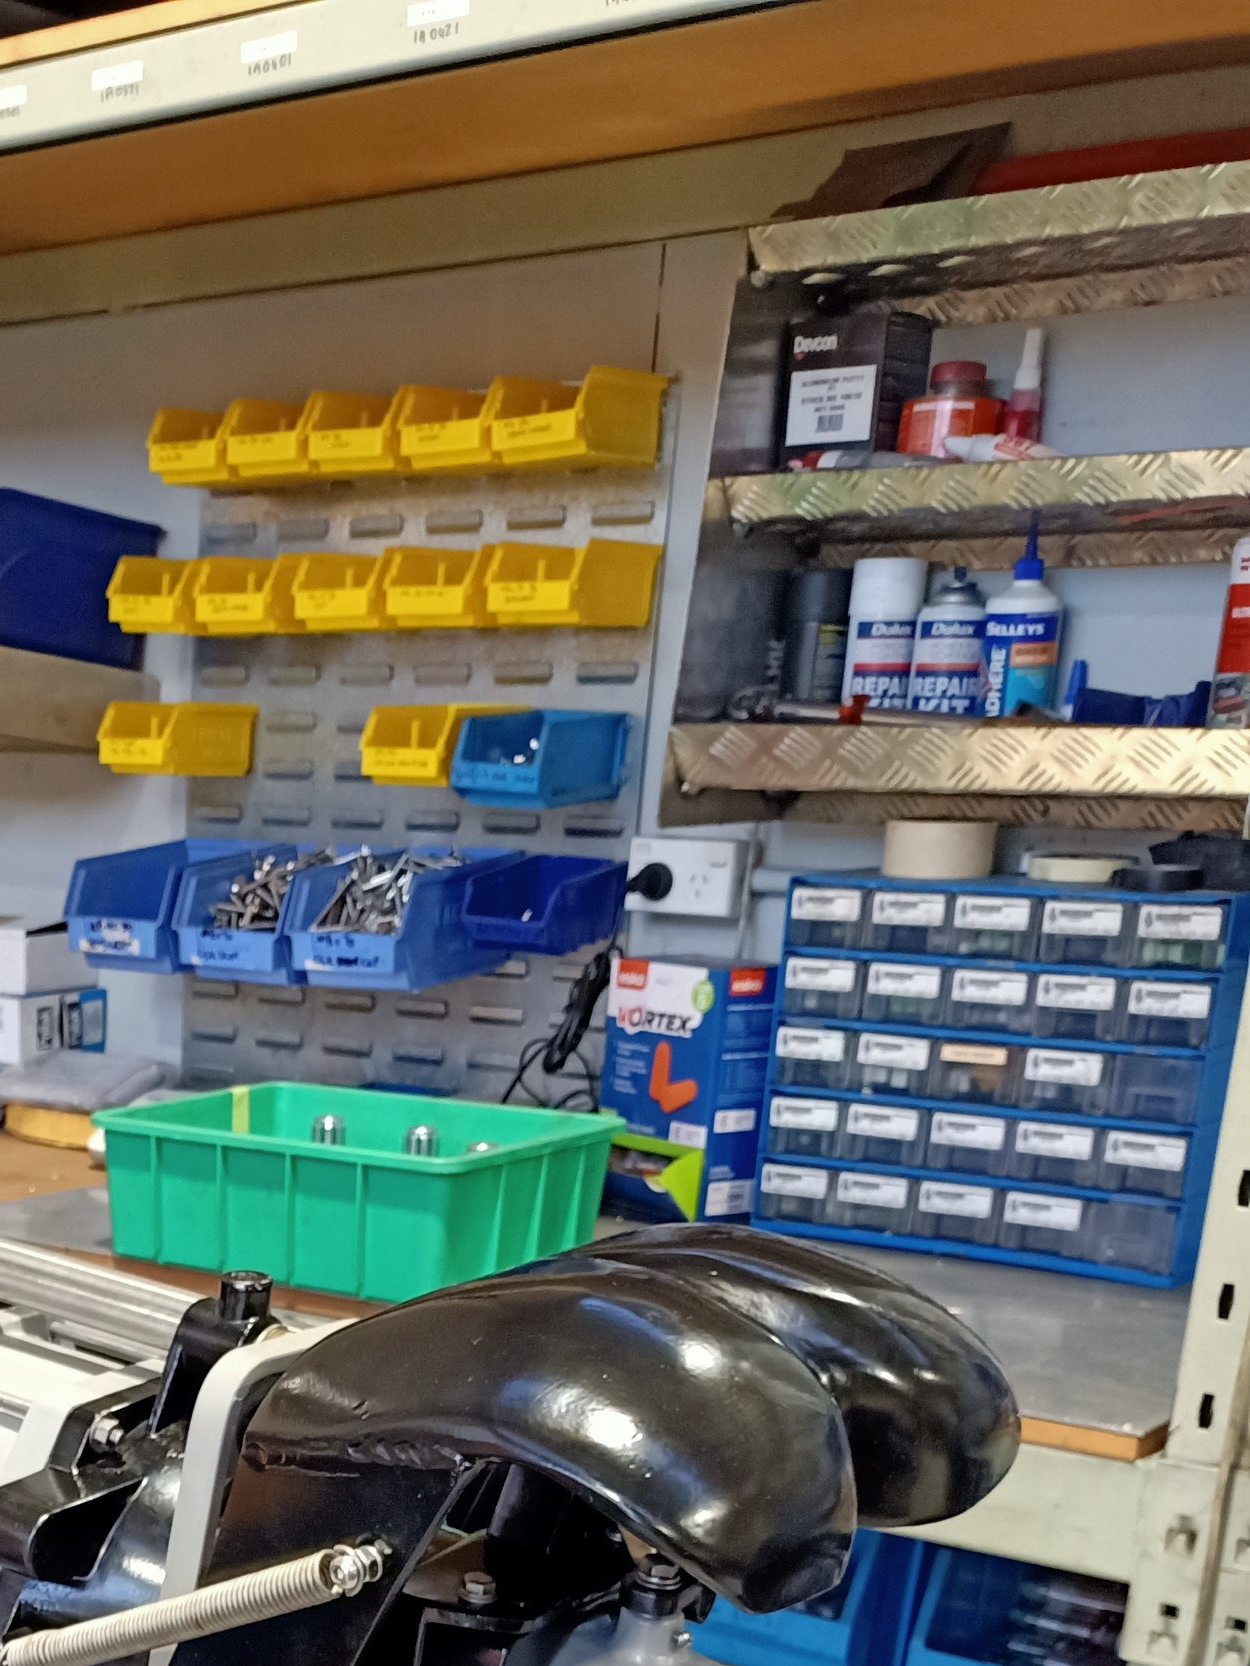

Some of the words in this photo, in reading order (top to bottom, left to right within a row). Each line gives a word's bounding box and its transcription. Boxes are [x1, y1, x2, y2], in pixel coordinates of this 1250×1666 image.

[793, 333, 838, 353] Devcon
[870, 622, 914, 637] Dulux
[930, 621, 976, 637] Dulux
[617, 1007, 692, 1033] VORTEX
